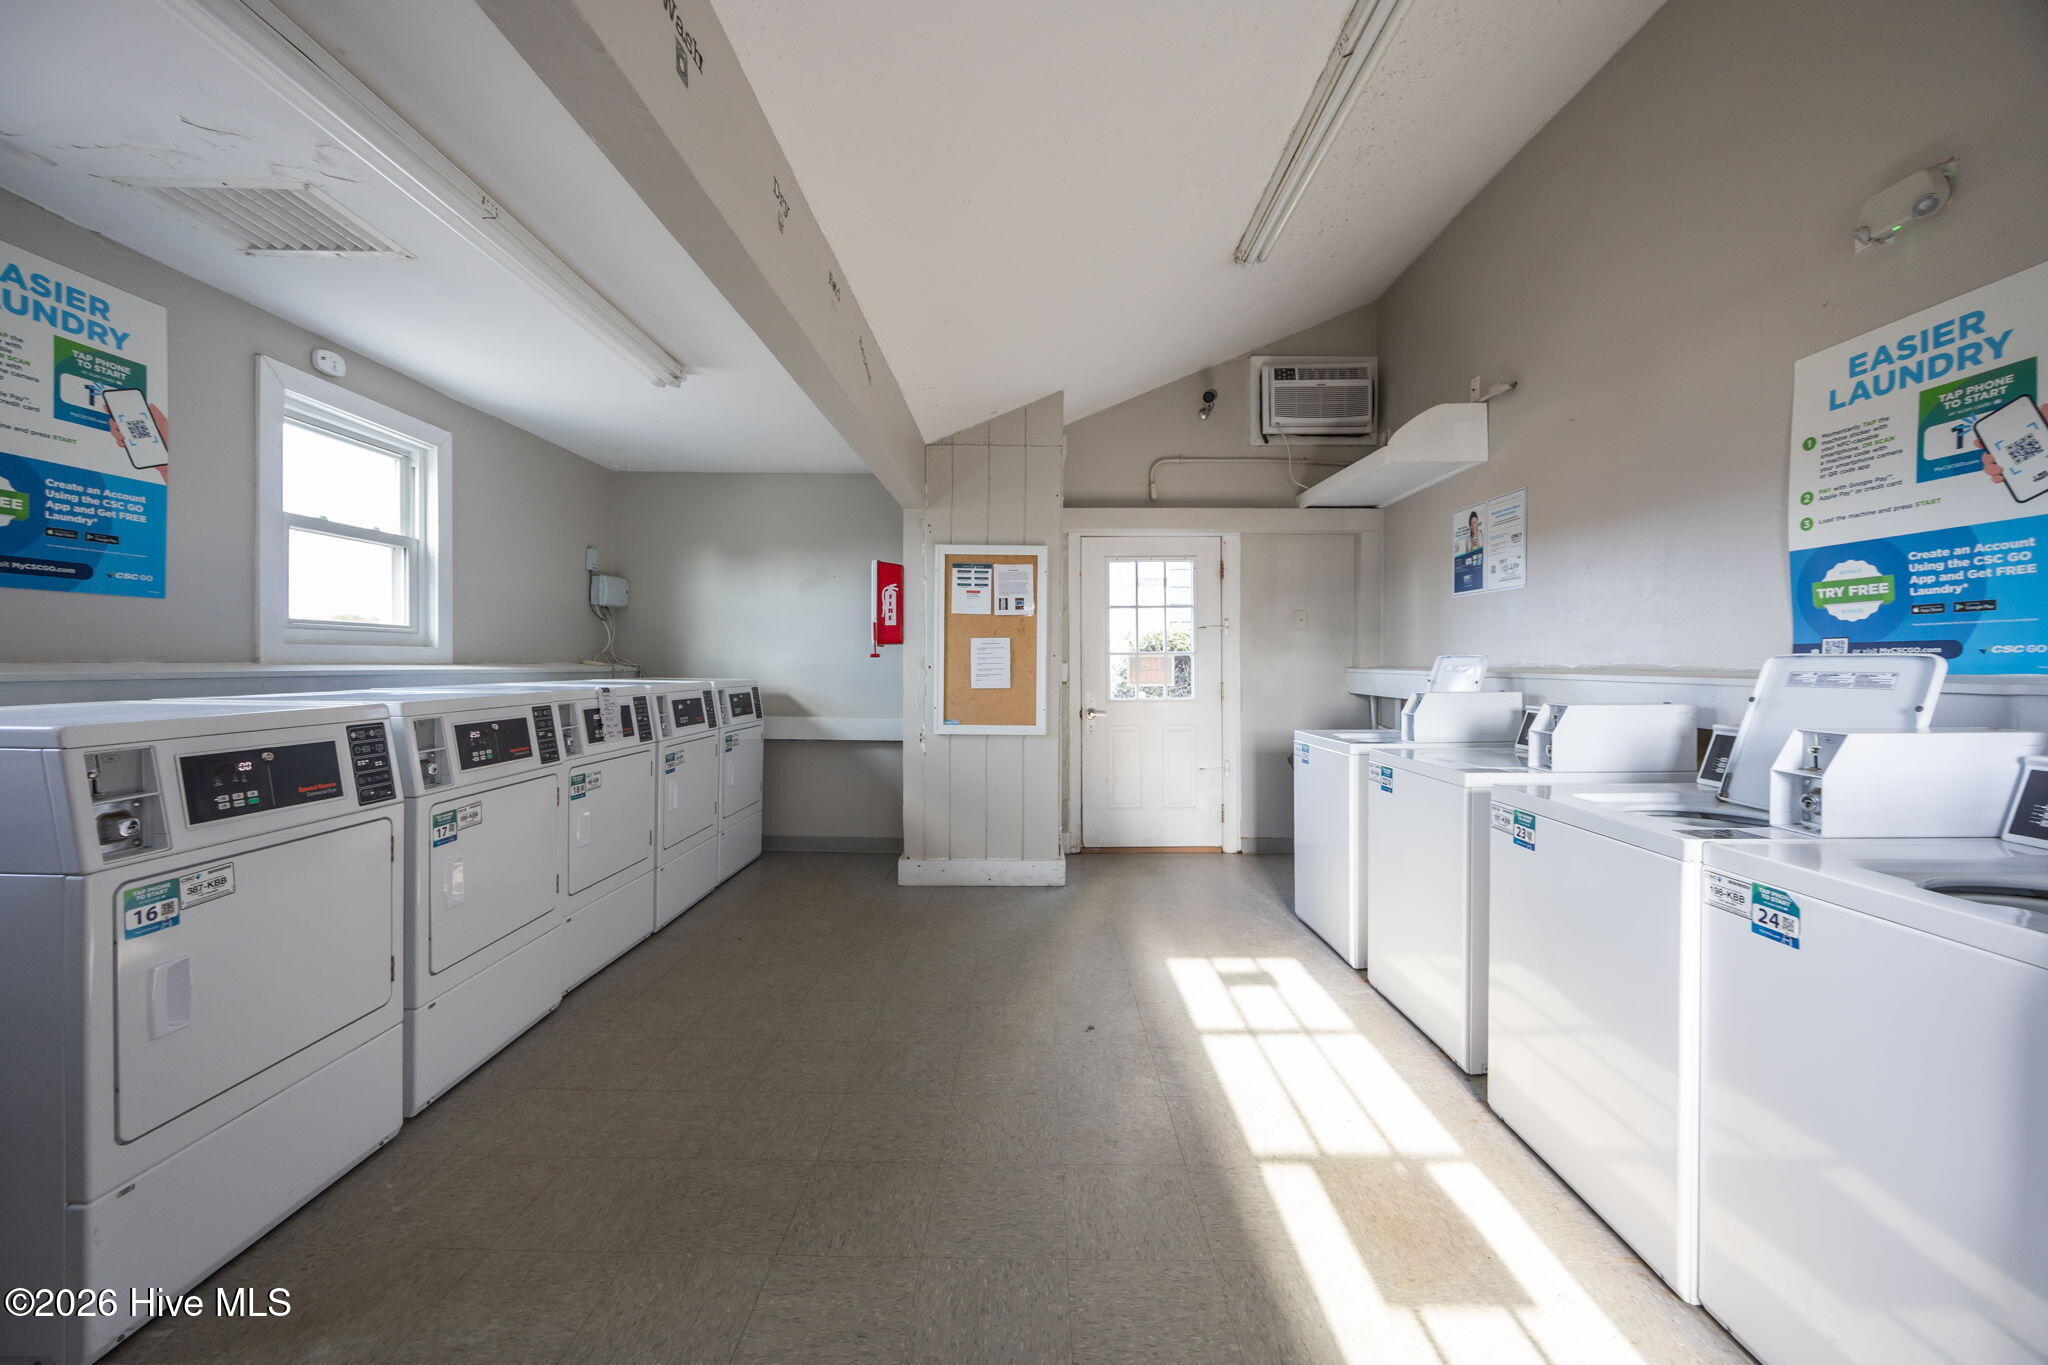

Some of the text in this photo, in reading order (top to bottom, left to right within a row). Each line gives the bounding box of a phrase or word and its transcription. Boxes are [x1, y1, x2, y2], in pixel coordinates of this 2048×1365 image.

[663, 0, 703, 75] Wash
[773, 175, 790, 218] Dry
[0, 263, 111, 322] ASIER
[0, 288, 131, 350] UNDRY
[1849, 310, 1985, 378] EASIER
[7, 355, 31, 367] SCAN
[72, 349, 131, 375] TAP PHONE
[76, 359, 92, 369] TO
[94, 365, 127, 380] START
[1828, 329, 2014, 411] LAUNDRY
[10, 371, 39, 383] camera
[1938, 374, 2015, 403] TAP PHONE
[1943, 385, 2008, 410] TO START
[53, 434, 77, 444] START
[1821, 436, 1848, 445] machine
[1850, 429, 1871, 438] sticker
[1822, 425, 1860, 437] Momentarily
[1874, 436, 1895, 445] SCAN
[1825, 455, 1852, 463] machine
[1835, 456, 1875, 468] smartphone
[1876, 449, 1903, 459] camera
[45, 478, 146, 504] Create an Account
[1819, 493, 1837, 501] Apple
[1864, 484, 1885, 492] credit
[1886, 479, 1903, 488] card
[1848, 480, 1873, 488] Google
[0, 497, 23, 510] EE
[45, 488, 144, 512] Using the CSC GO
[1848, 510, 1876, 518] machine
[1893, 504, 1913, 512] press
[1915, 497, 1942, 507] START
[45, 500, 147, 523] App and Get FREE
[1802, 520, 1810, 529] 3
[1908, 537, 2036, 561] Create an Account
[11, 562, 76, 574] MyCSCGO.com
[1908, 551, 2032, 573] Using the CSC GO
[115, 572, 139, 580] CSC
[1909, 564, 2037, 586] App and Get FREE
[1816, 582, 1889, 599] TRY FREE
[2026, 645, 2047, 653] GO
[437, 826, 447, 838] 17
[1517, 826, 1526, 839] 23
[187, 877, 227, 895] 387-KBB
[1710, 886, 1745, 904] 198-KBB
[134, 906, 158, 925] 16
[1758, 908, 1779, 928] 24
